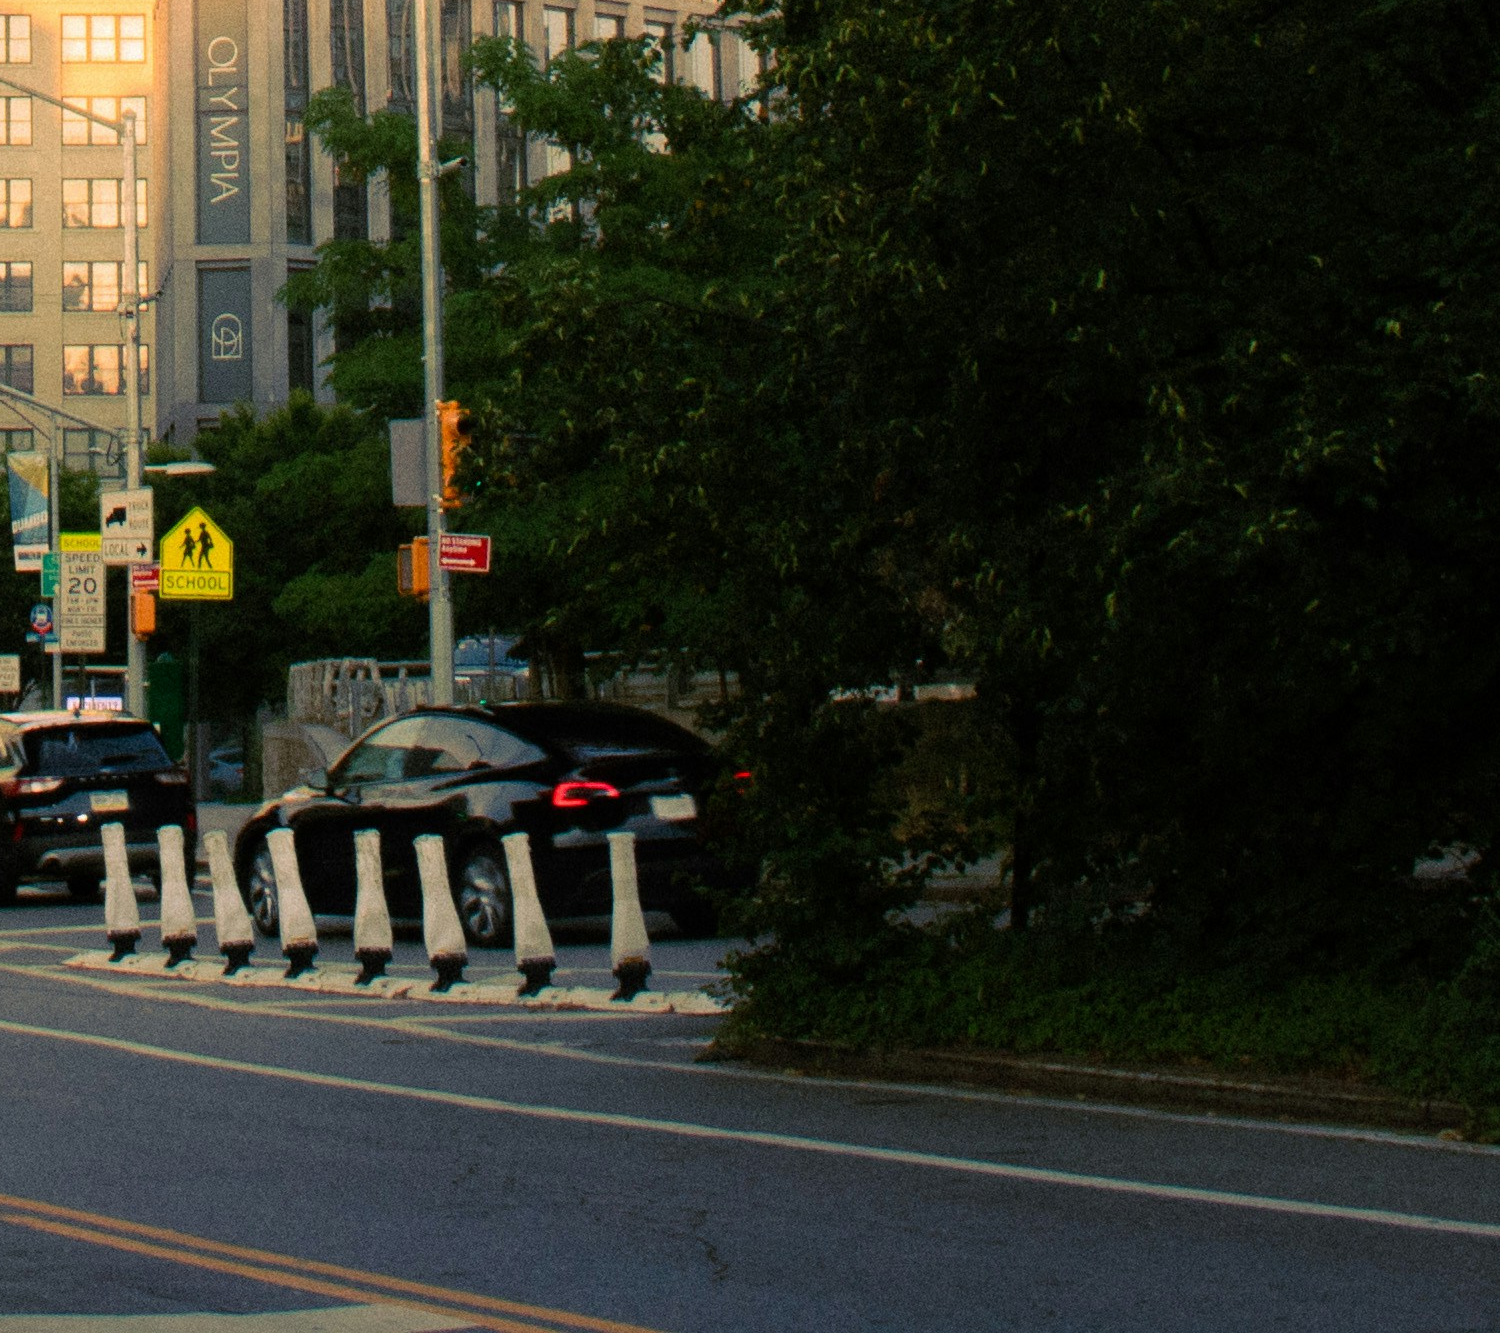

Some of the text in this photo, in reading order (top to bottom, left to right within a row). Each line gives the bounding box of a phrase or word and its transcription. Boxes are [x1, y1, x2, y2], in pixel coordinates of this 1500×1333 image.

[207, 36, 239, 203] OLYMPIA
[128, 519, 149, 529] ROUTE
[64, 540, 101, 548] SCHOOL
[104, 544, 128, 557] LOCAL
[65, 554, 100, 563] SPEED
[69, 566, 95, 574] LIMIT
[68, 578, 97, 594] 20
[165, 576, 226, 590] SCHOOL
